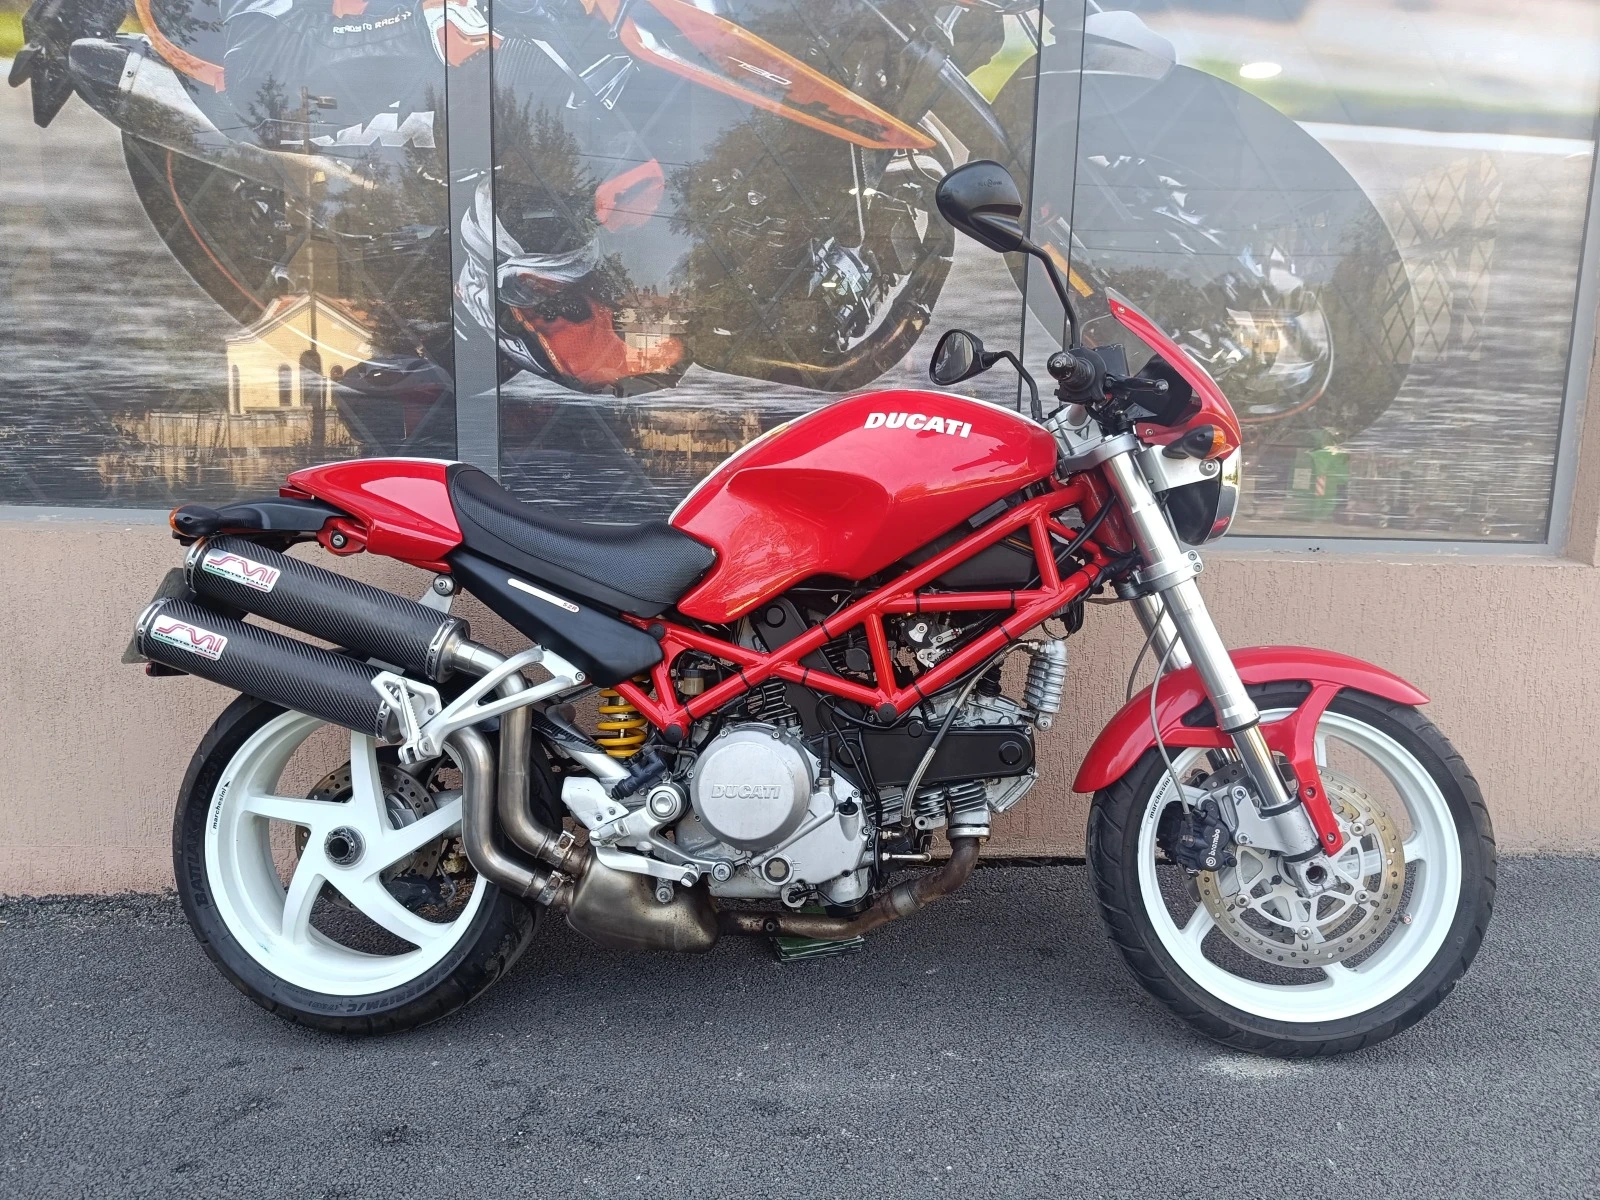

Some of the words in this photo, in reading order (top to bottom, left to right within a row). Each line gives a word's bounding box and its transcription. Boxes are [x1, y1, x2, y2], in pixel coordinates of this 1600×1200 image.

[332, 25, 362, 34] READY
[375, 14, 401, 29] RACE
[863, 412, 973, 438] DUCATI
[242, 576, 269, 588] ITALIA
[190, 643, 217, 656] ITALIA
[711, 784, 782, 799] DUCATI
[1149, 776, 1171, 819] marchesini
[212, 788, 228, 830] marchesini
[1208, 829, 1221, 857] brembo
